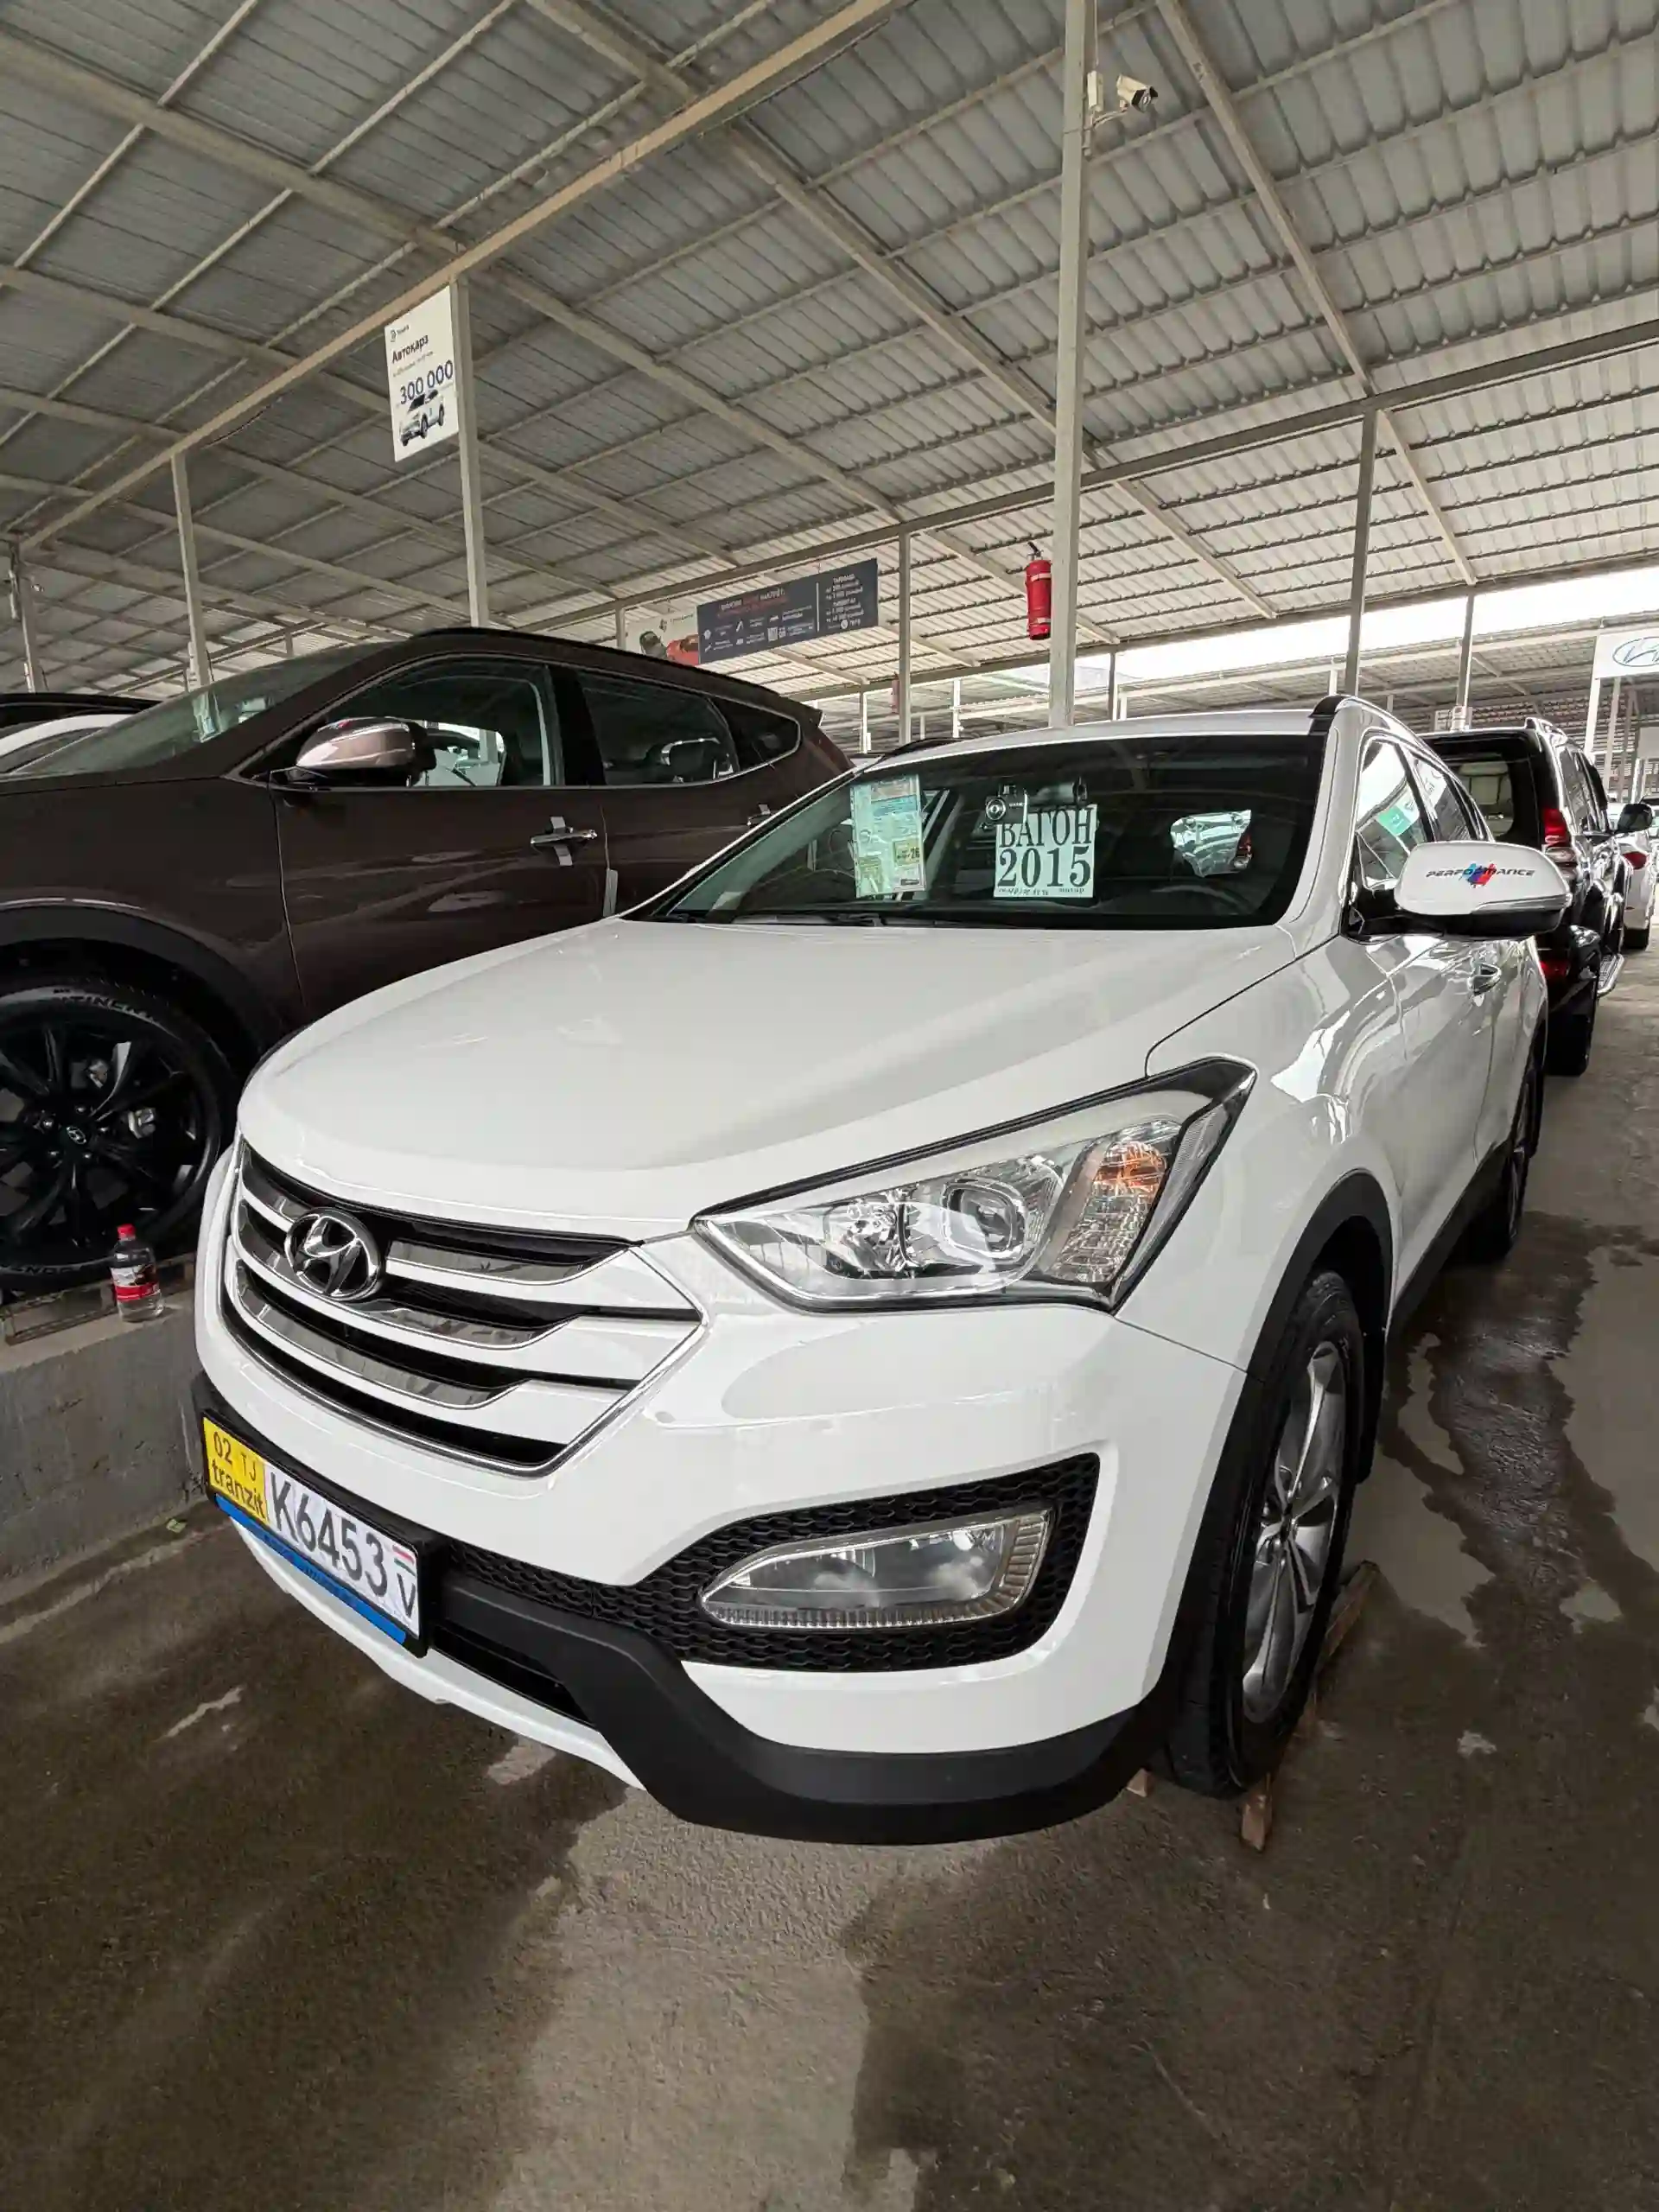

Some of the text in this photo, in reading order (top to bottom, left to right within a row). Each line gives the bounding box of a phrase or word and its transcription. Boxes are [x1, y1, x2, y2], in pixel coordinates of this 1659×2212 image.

[400, 377, 423, 404] 300
[427, 359, 454, 388] 000
[997, 845, 1091, 887] 2015
[213, 1431, 257, 1481] 02 TJ
[212, 1458, 267, 1522] tranzit
[270, 1472, 416, 1618] K6453 V
